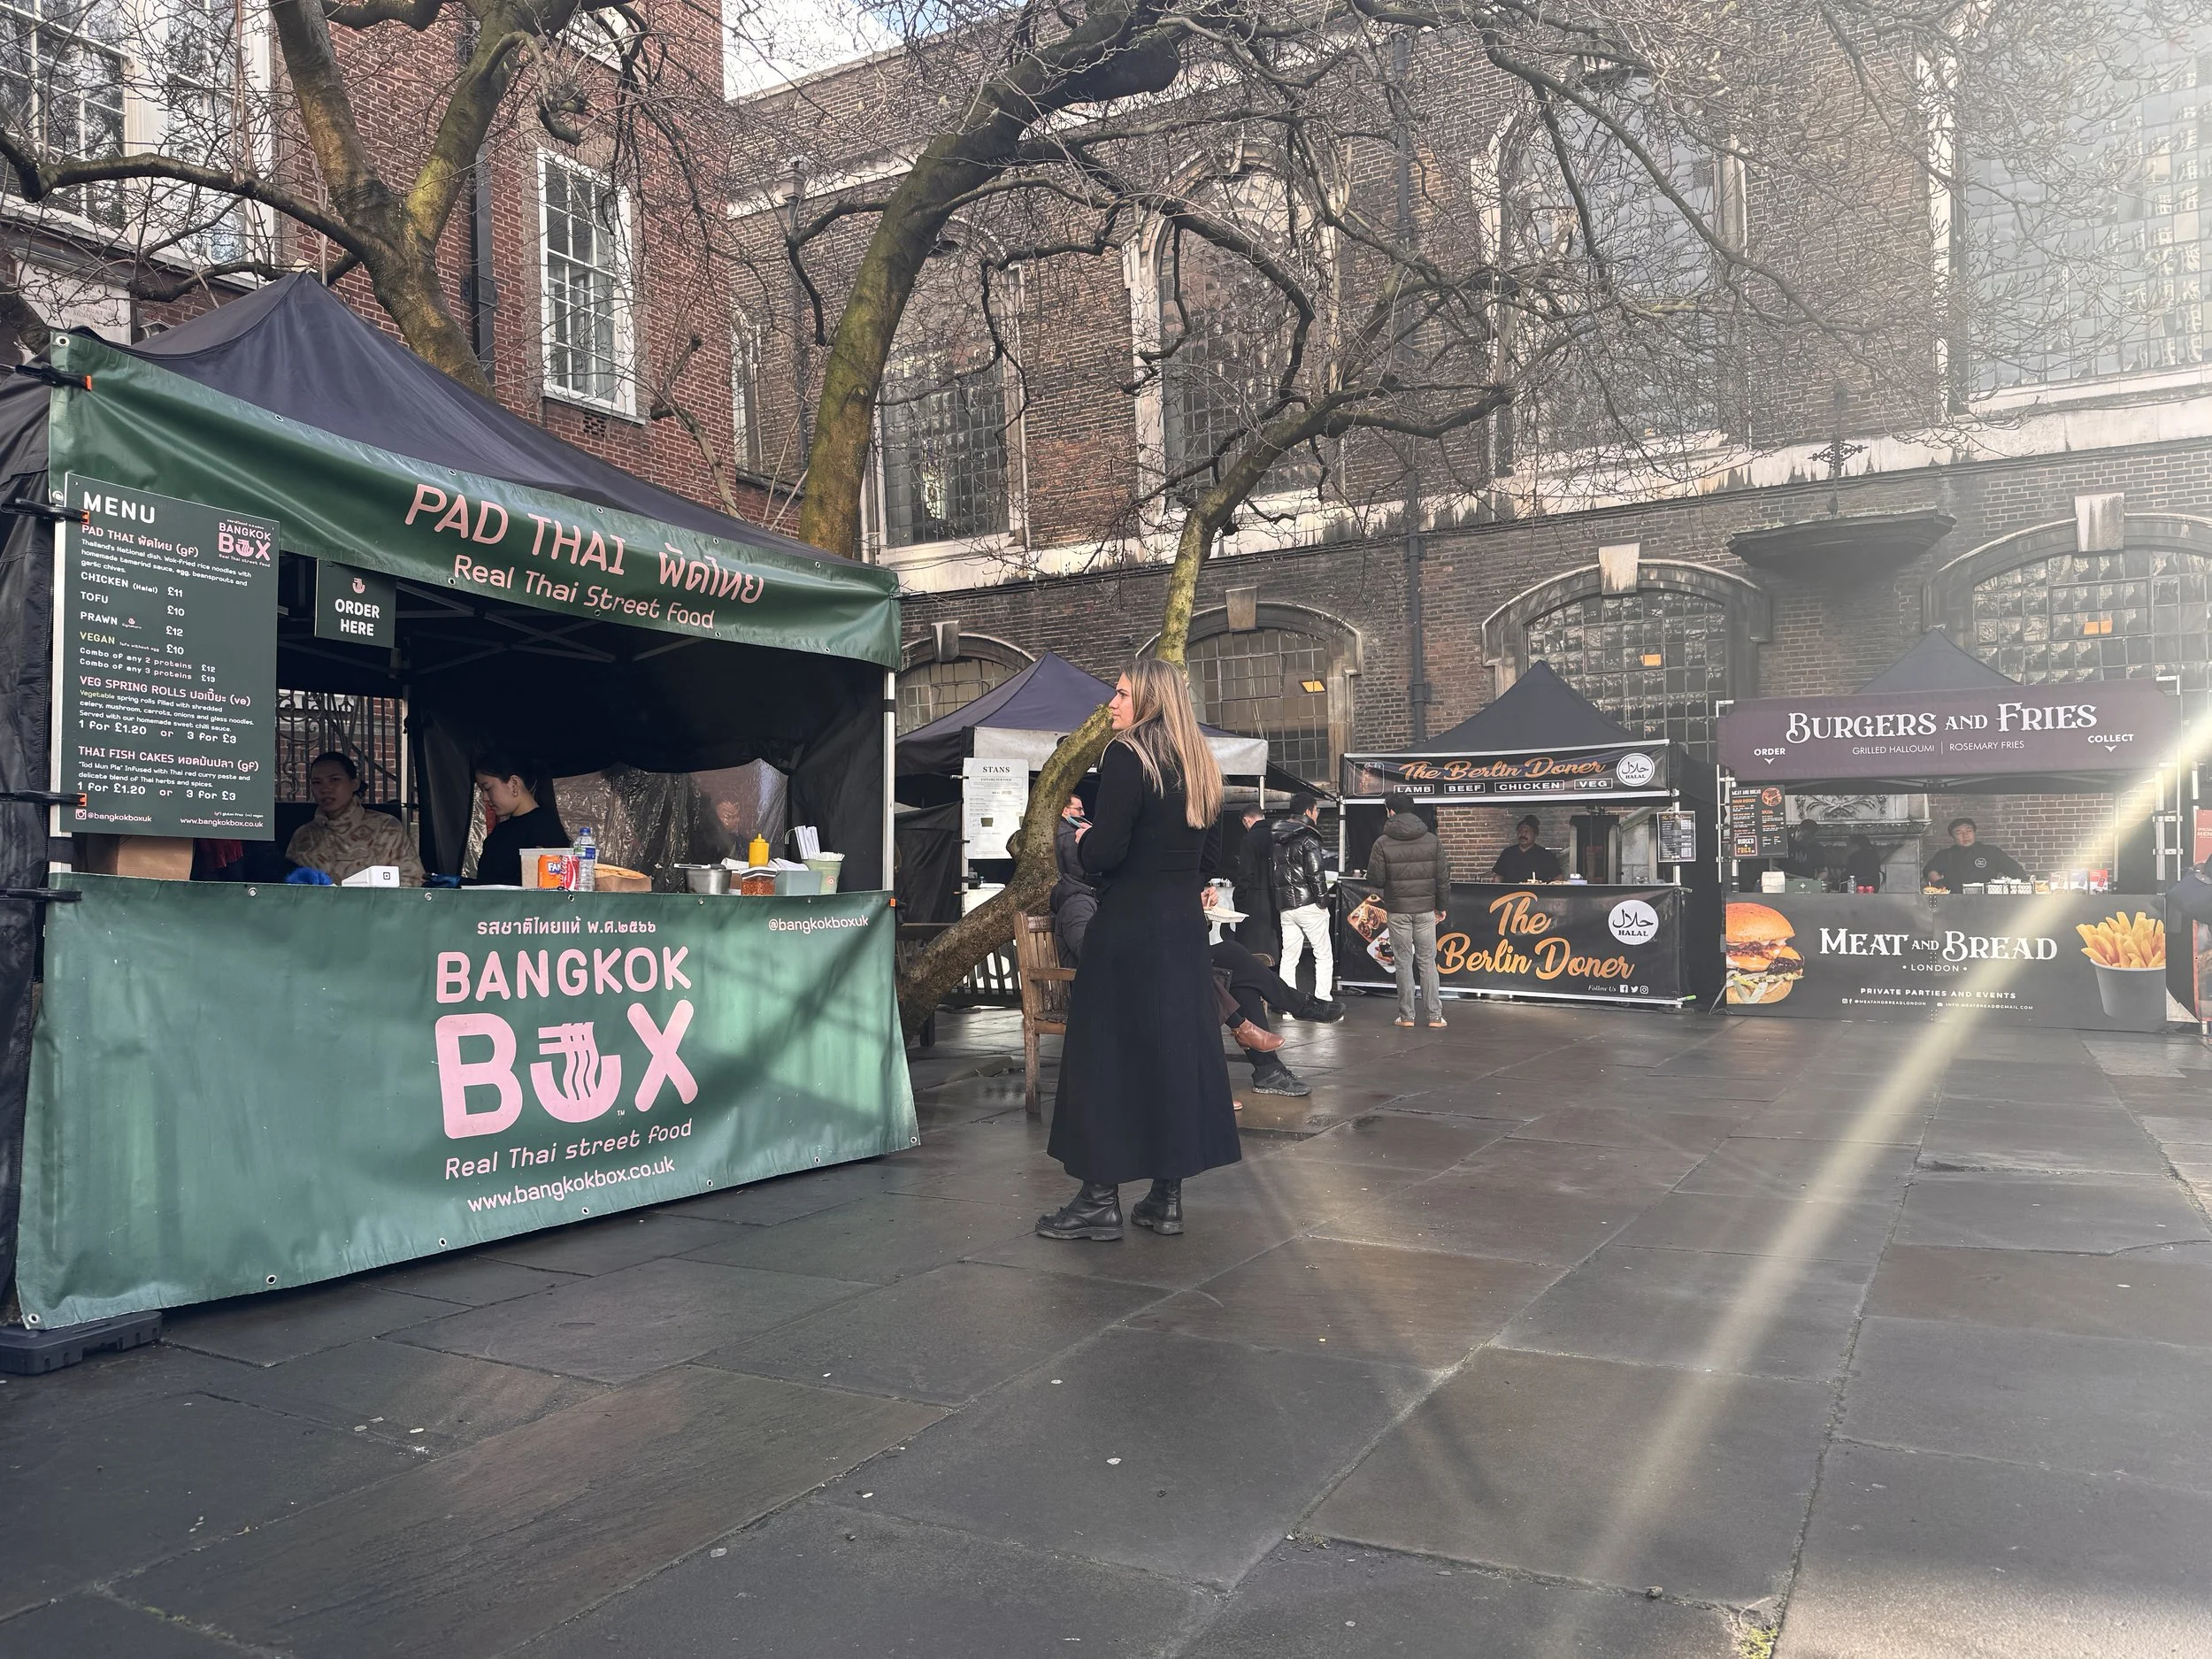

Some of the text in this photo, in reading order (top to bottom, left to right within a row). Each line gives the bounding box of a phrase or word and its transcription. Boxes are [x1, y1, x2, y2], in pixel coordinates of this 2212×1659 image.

[83, 491, 155, 524] MENU
[81, 524, 198, 557] PAD THAI ผัดไทย (gf)
[219, 522, 271, 541] BANGKOK
[404, 484, 764, 603] PAD THAI ผัดไทย
[81, 559, 101, 568] garlic
[116, 546, 145, 557] National
[211, 565, 236, 575] noodles
[81, 571, 182, 597] CHICKEN (Halal) £11
[455, 555, 715, 629] Real Thai Street Food
[80, 590, 185, 616] TOFU £10
[334, 598, 380, 619] ORDER
[80, 611, 183, 636] PRAWN £12
[340, 618, 374, 637] HERE
[79, 631, 184, 655] VEGAN £10
[79, 657, 109, 668] Combo
[153, 670, 191, 680] proteins
[201, 673, 215, 682] £13
[80, 647, 109, 657] Combo
[154, 659, 191, 669] proteins
[201, 664, 215, 672] £12
[79, 675, 101, 687] VEG
[104, 679, 147, 693] SPRING
[151, 685, 186, 697] ROLLS
[229, 694, 250, 707] (ve)
[80, 689, 115, 699] Vegetable
[116, 695, 139, 703] spring
[191, 703, 222, 712] shredded
[79, 709, 104, 718] Served
[136, 716, 172, 726] homemade
[1786, 702, 2098, 743] BURGERS AND FRIES
[78, 718, 83, 728] 1
[88, 720, 110, 730] for
[114, 721, 147, 734] £1.20
[187, 731, 194, 740] 3
[198, 732, 218, 741] for
[222, 733, 236, 743] £3
[2087, 733, 2134, 743] COLLECT
[78, 745, 258, 772] THAI FISH CAKES ทอดมันปลา (gf)
[1889, 744, 1935, 753] HALLOUMI
[1949, 741, 1998, 751] ROSEMARY
[78, 771, 107, 780] delicate
[1399, 757, 1606, 781] The Berlin Doner
[1621, 762, 1650, 774] حلال
[77, 780, 82, 790] 1
[88, 781, 109, 792] for
[113, 782, 145, 795] £1.20
[186, 788, 193, 798] 3
[197, 789, 217, 799] for
[221, 790, 235, 801] £3
[1500, 781, 1560, 790] CHICKEN
[87, 811, 152, 822] @bangkokboxuk
[180, 818, 263, 827] www.bangkokbox.co.uk
[768, 916, 869, 933] @bangkokboxuk
[1489, 891, 1552, 936] The
[1612, 909, 1655, 928] حلال
[477, 917, 581, 935] รสชาติไทยแท้
[1437, 932, 1635, 980] Berlin Doner
[1819, 927, 2058, 962] MEAT AND BREAD
[436, 946, 691, 1003] BANGKOK
[1911, 964, 1959, 972] LONDON
[445, 1118, 692, 1180] Real Thai street food
[467, 1156, 675, 1213] www.bangkokbox.co.uk
